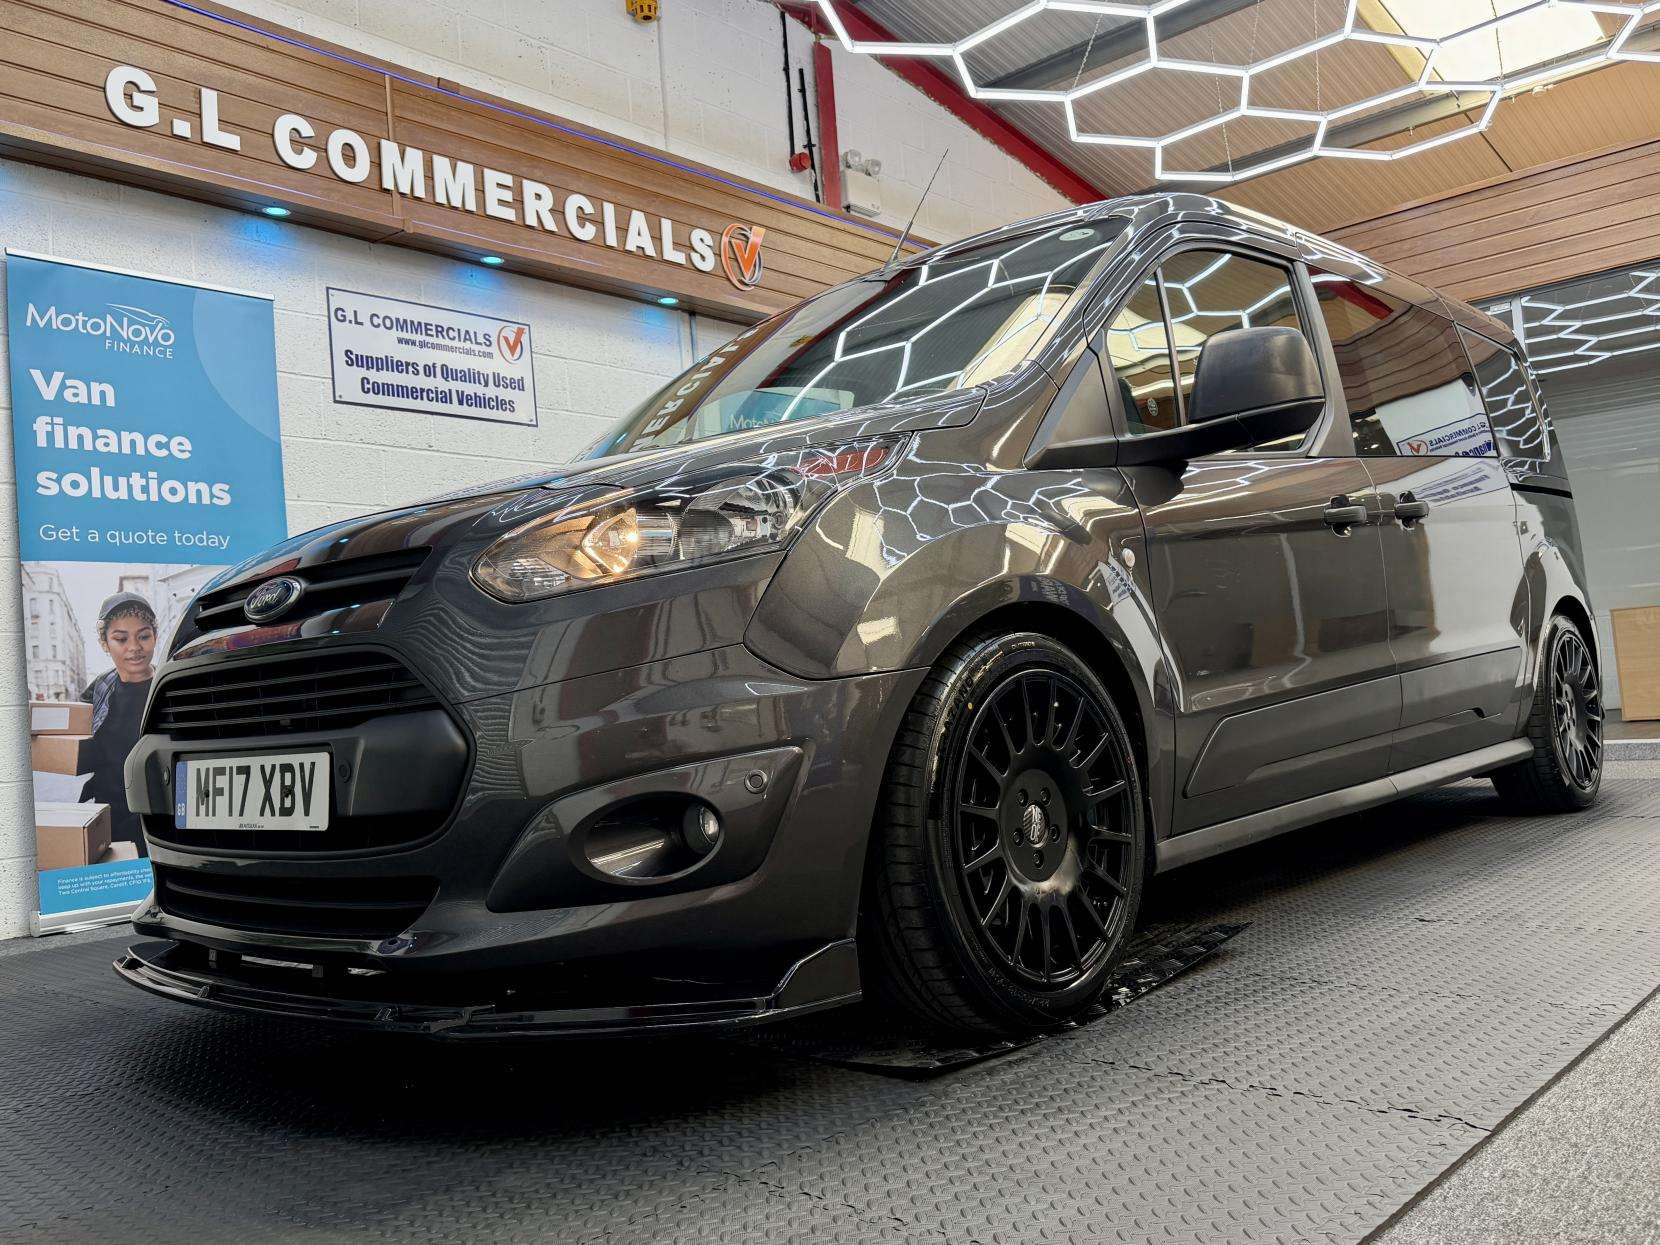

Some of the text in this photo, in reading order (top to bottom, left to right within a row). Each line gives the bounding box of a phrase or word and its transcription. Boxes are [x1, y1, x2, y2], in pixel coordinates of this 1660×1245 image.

[104, 65, 716, 272] G.L COMMERCIALS
[25, 302, 175, 346] MotoNovo
[334, 307, 493, 347] G.L COMMERCIALS
[105, 339, 174, 359] FINANCE
[396, 336, 494, 360] www.glcommercials.com
[29, 368, 116, 407] Van
[344, 349, 526, 391] Suppliers of Quality Used
[360, 377, 516, 413] Commercial Vehicles
[33, 415, 193, 459] finance
[35, 467, 232, 506] solutions
[39, 524, 231, 550] Get a quote today
[250, 588, 282, 609] Ford
[195, 761, 316, 817] MF17 XBV
